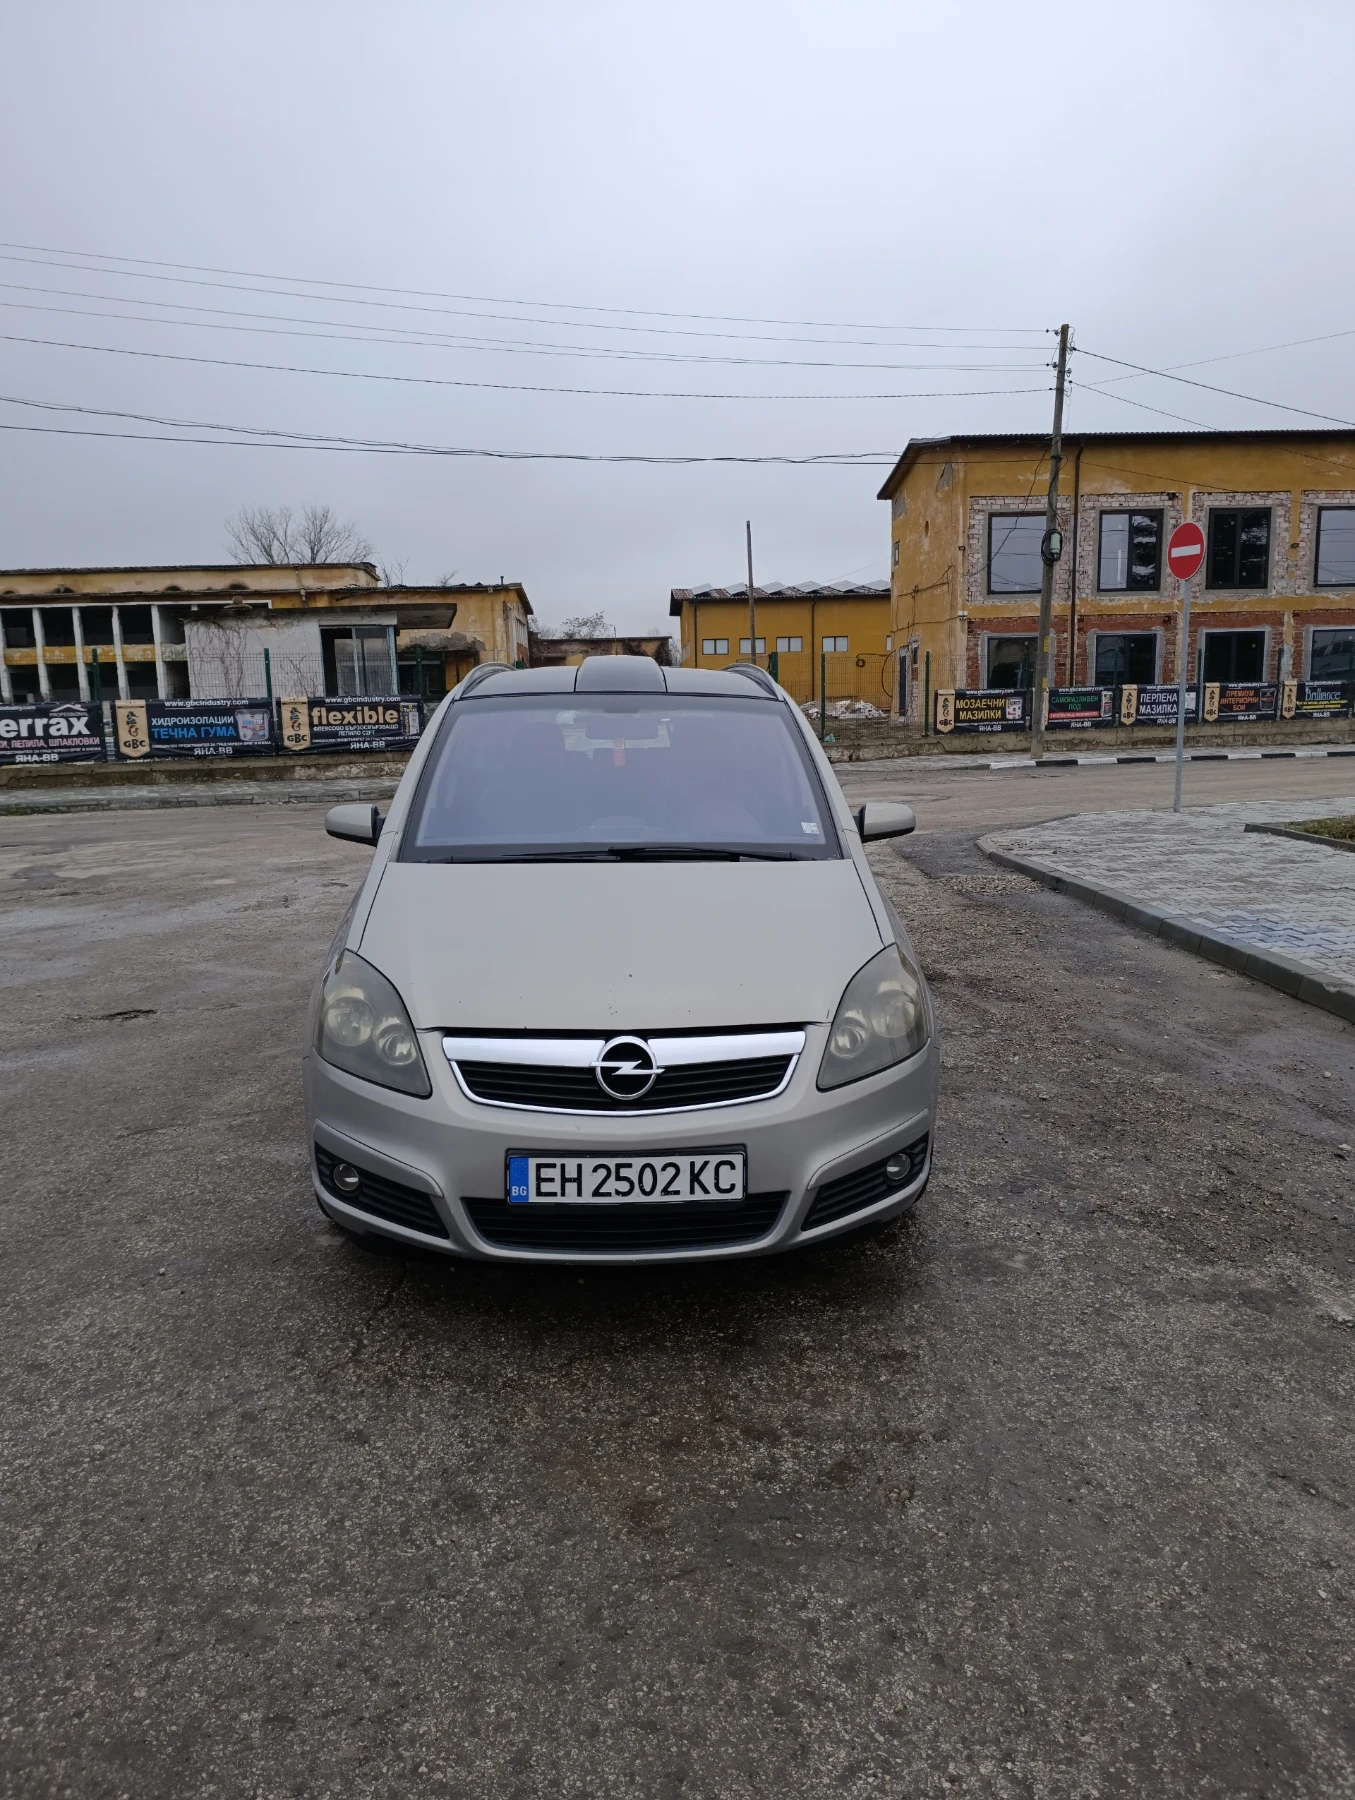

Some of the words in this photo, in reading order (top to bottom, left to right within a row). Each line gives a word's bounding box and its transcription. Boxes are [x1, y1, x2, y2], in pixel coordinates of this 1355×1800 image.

[1051, 695, 1099, 703] САМОРАЗЛИВЕН
[1140, 692, 1178, 703] ПЕРЛЕНА
[1305, 688, 1341, 701] Brilliance
[164, 699, 249, 708] www.gbcindustry.com
[324, 696, 401, 704] www.gbcindustry.com
[955, 698, 1005, 709] МОЗАЕЧНИ
[1068, 703, 1081, 711] ПОД
[1139, 704, 1178, 714] МАЗИЛКА
[311, 706, 399, 725] flexible
[959, 709, 1002, 720] МАЗИЛКИ
[151, 715, 234, 727] ХИДРОИЗОЛАЦИИ
[939, 718, 953, 726] GBC
[0, 717, 91, 738] errax
[151, 727, 198, 739] ТЕЧНА
[201, 726, 237, 738] ГУМА
[11, 739, 48, 748] ЛЕПИЛА,
[49, 737, 100, 747] ШПАКЛОВКИ
[287, 733, 308, 743] GBC
[123, 739, 146, 749] GBC
[350, 741, 386, 749] ЯНА-ВВ
[194, 747, 233, 756] ЯНА-ВВ
[15, 753, 59, 763] ЯНА-ВВ
[591, 1162, 681, 1197] 2502
[511, 1186, 527, 1196] BG
